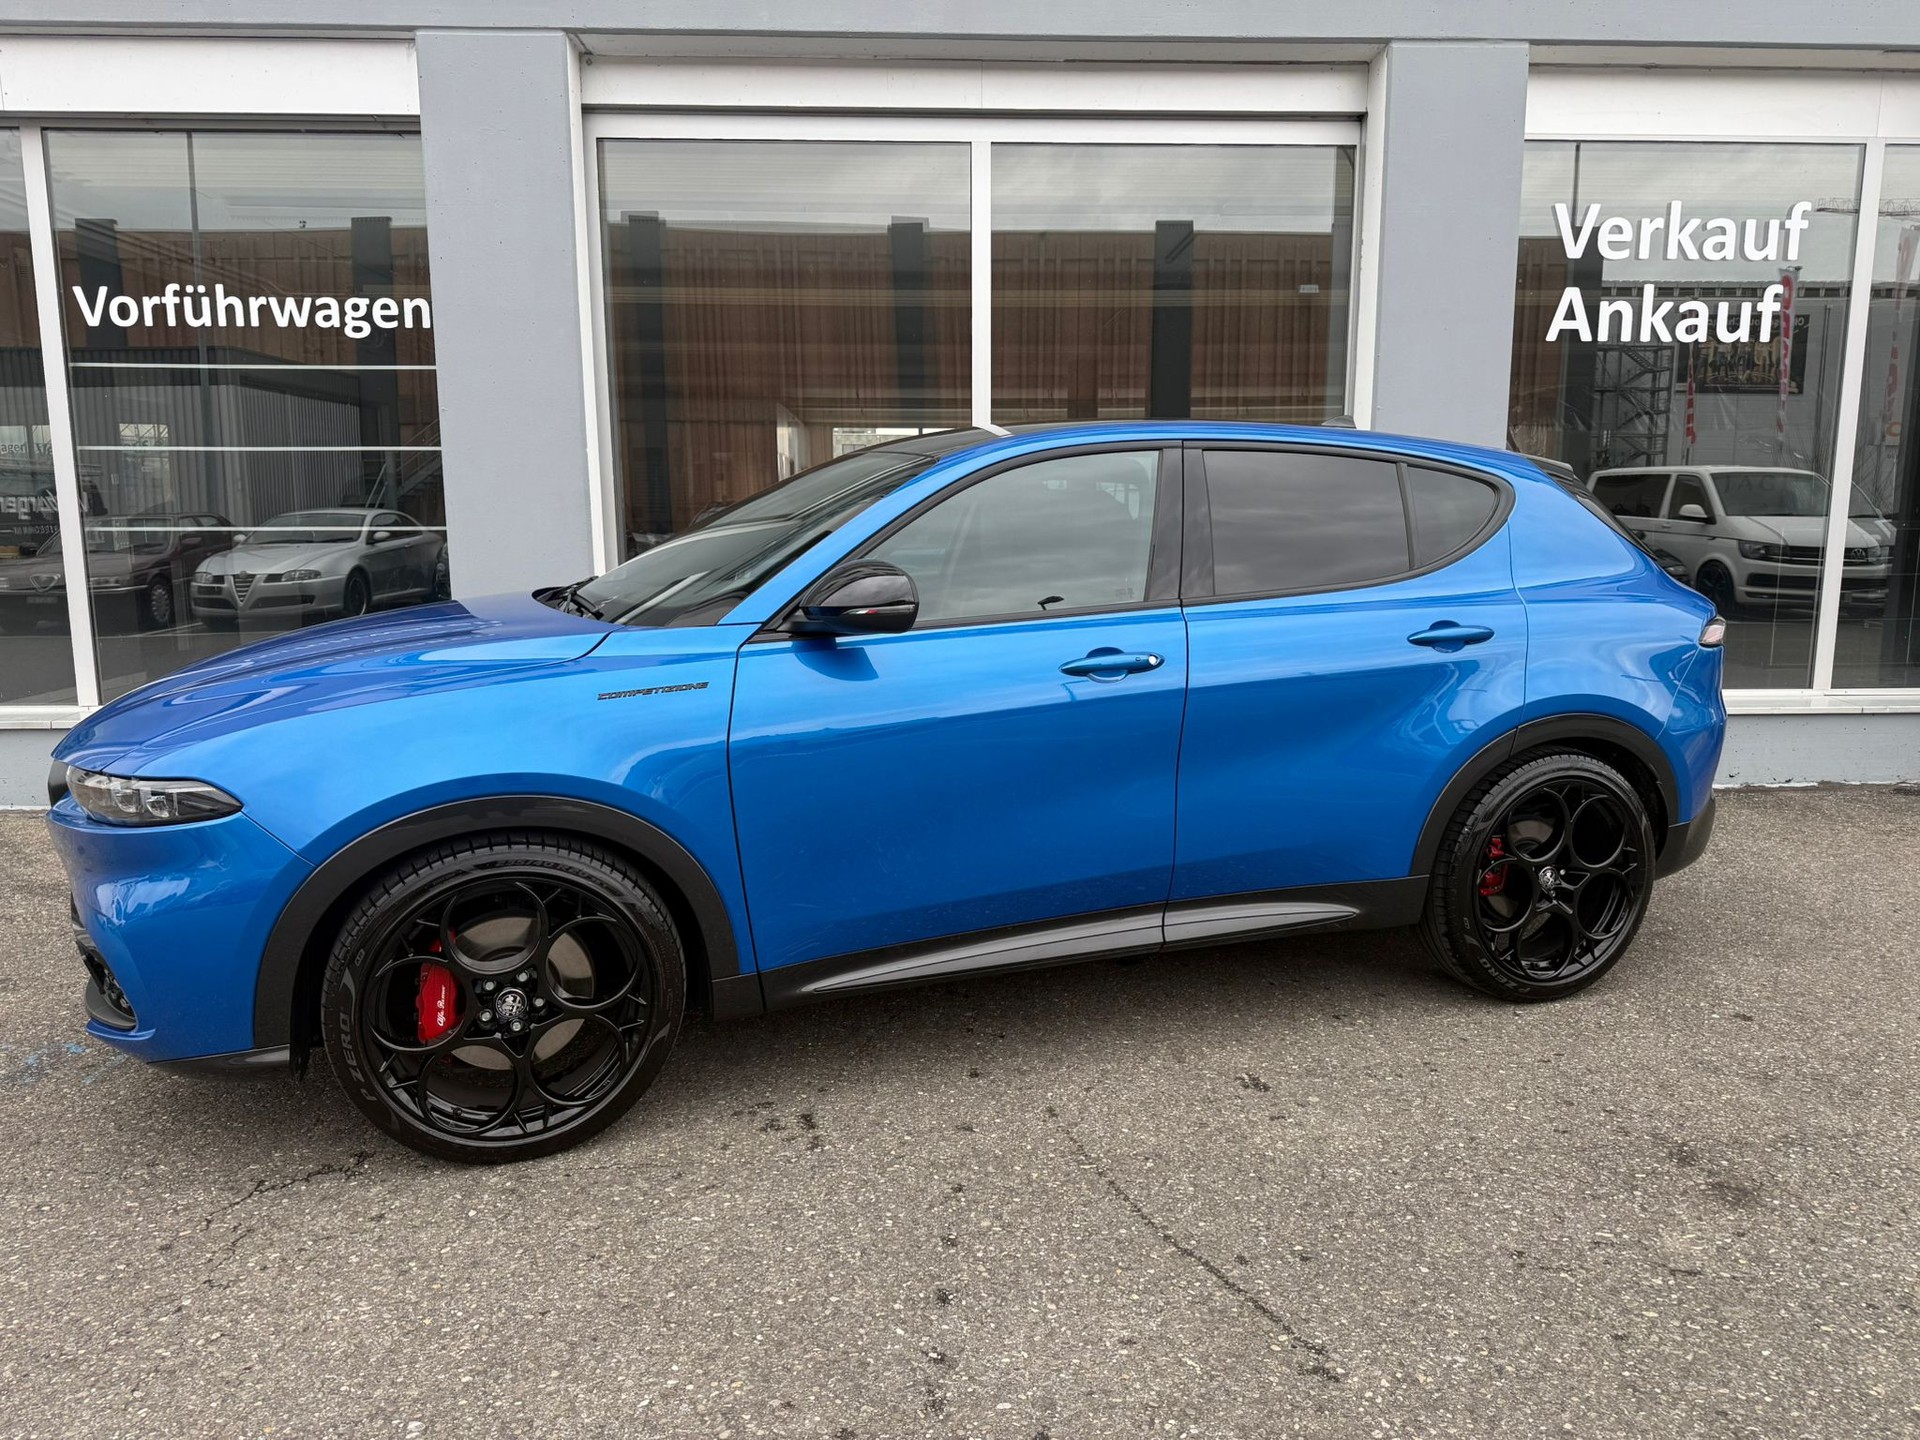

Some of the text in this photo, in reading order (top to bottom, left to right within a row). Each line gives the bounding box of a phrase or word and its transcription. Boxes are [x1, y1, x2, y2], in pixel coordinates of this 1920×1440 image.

[1554, 201, 1811, 262] Verkauf
[72, 283, 431, 339] Vorführwagen
[1546, 284, 1784, 343] Ankauf
[597, 681, 709, 700] COMPETIZIONE
[339, 1013, 365, 1083] ZERO
